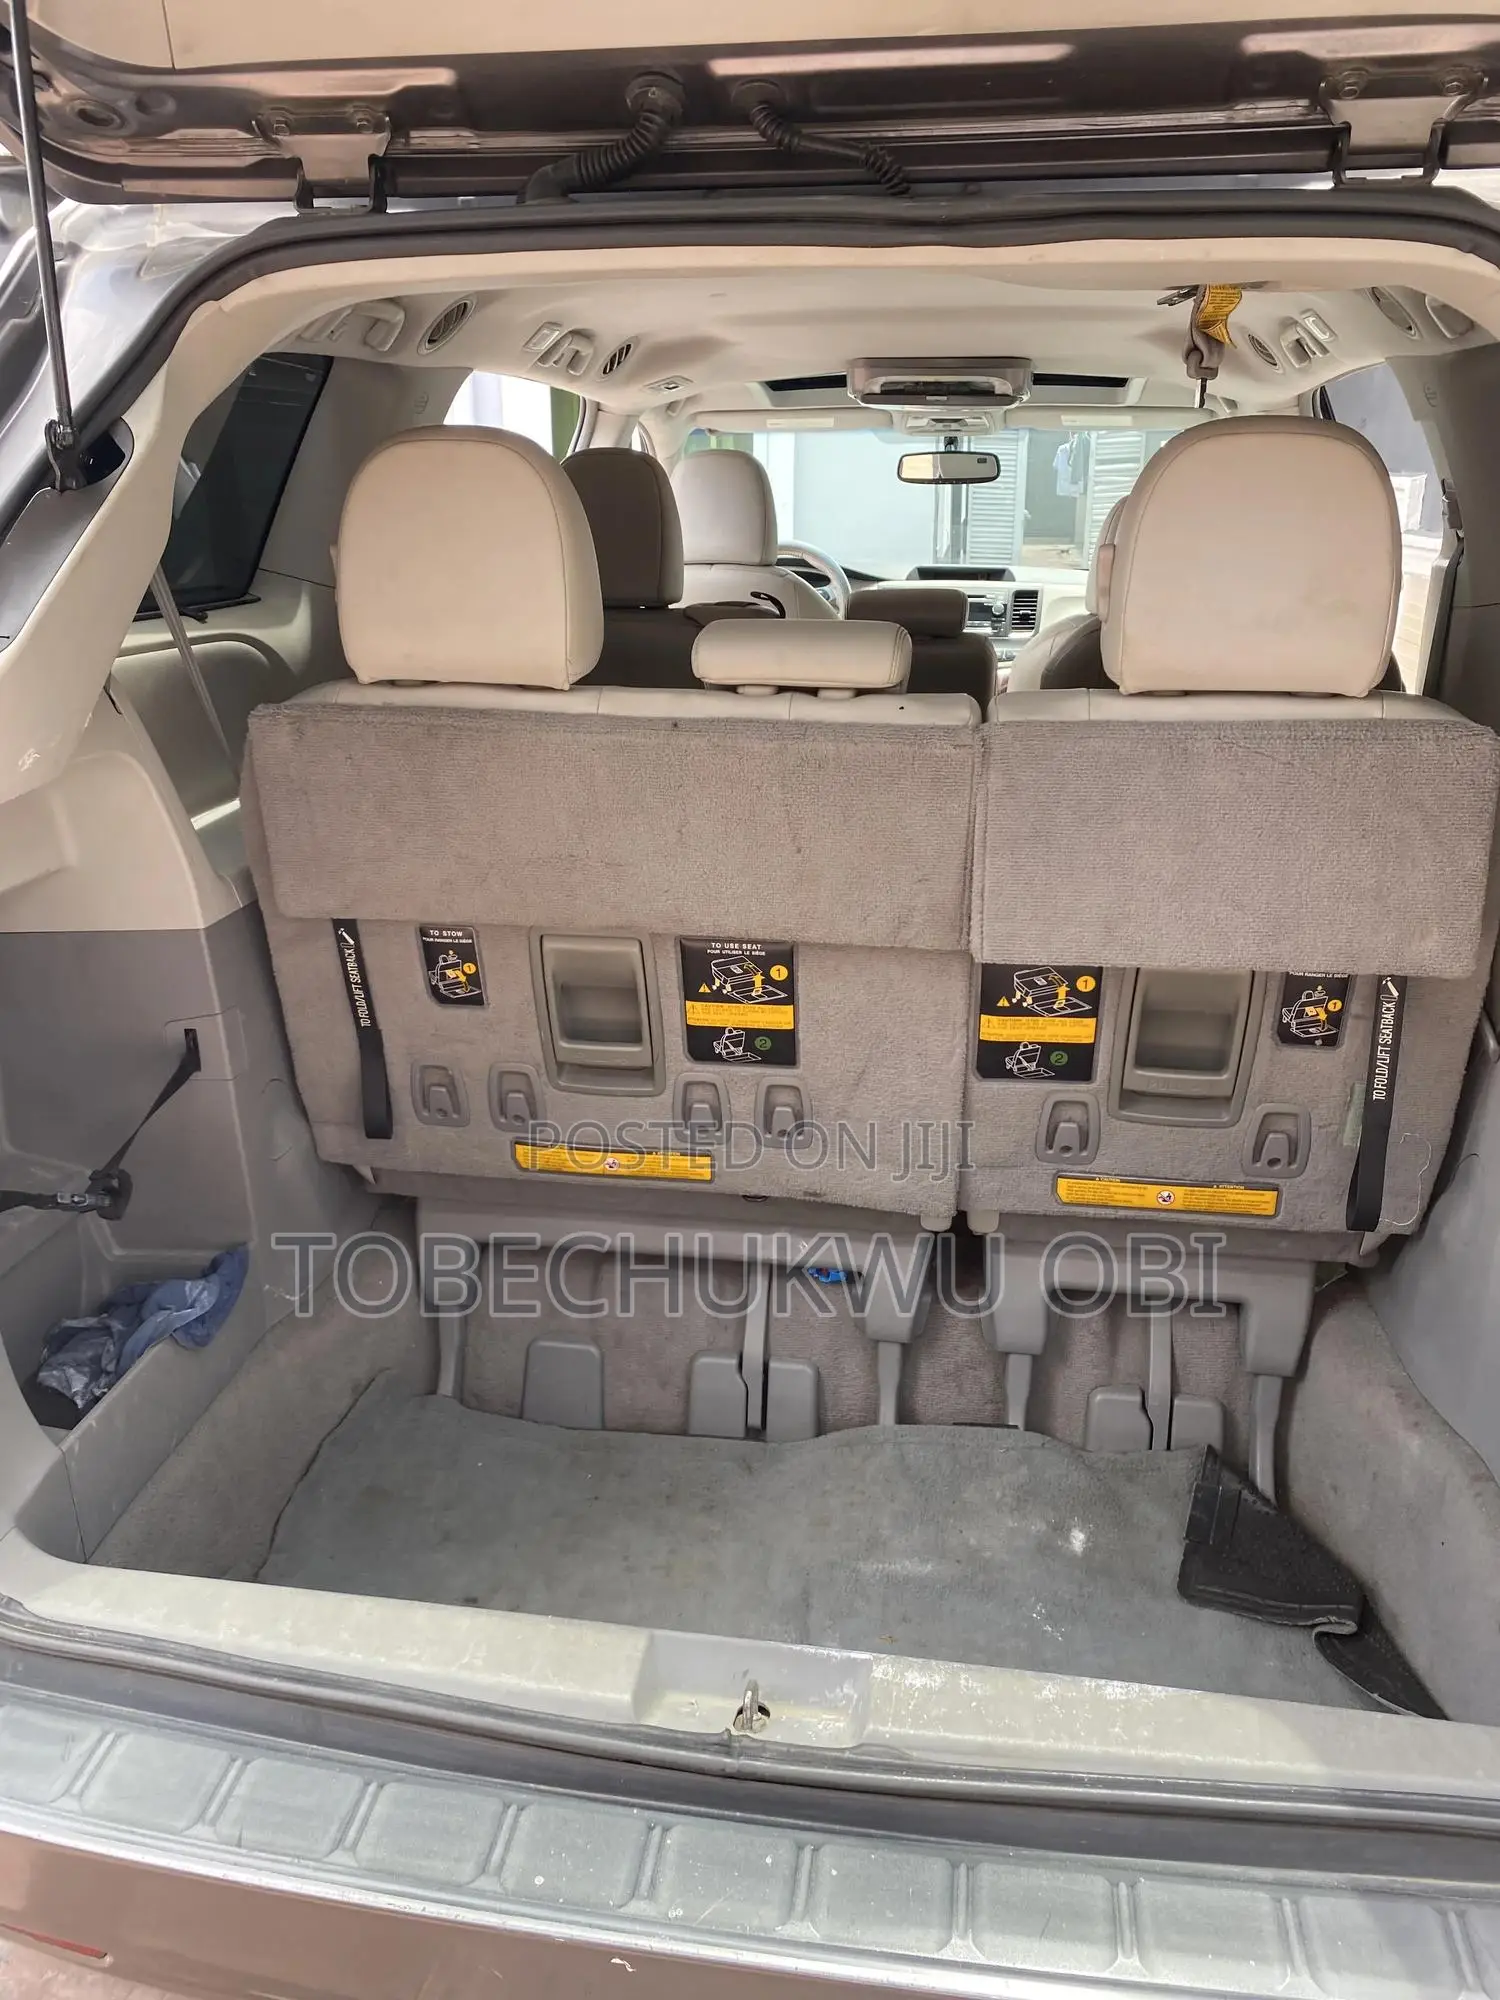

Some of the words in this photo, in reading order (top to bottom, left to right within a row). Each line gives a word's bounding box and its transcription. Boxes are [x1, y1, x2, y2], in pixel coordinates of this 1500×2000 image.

[344, 948, 361, 983] SEATBACK
[352, 984, 370, 1018] FOLD/LIFT
[360, 1018, 372, 1028] TO
[1379, 1001, 1397, 1045] SEATBACK
[1374, 1045, 1391, 1089] FOLD/LIFT
[1373, 1090, 1387, 1101] TO
